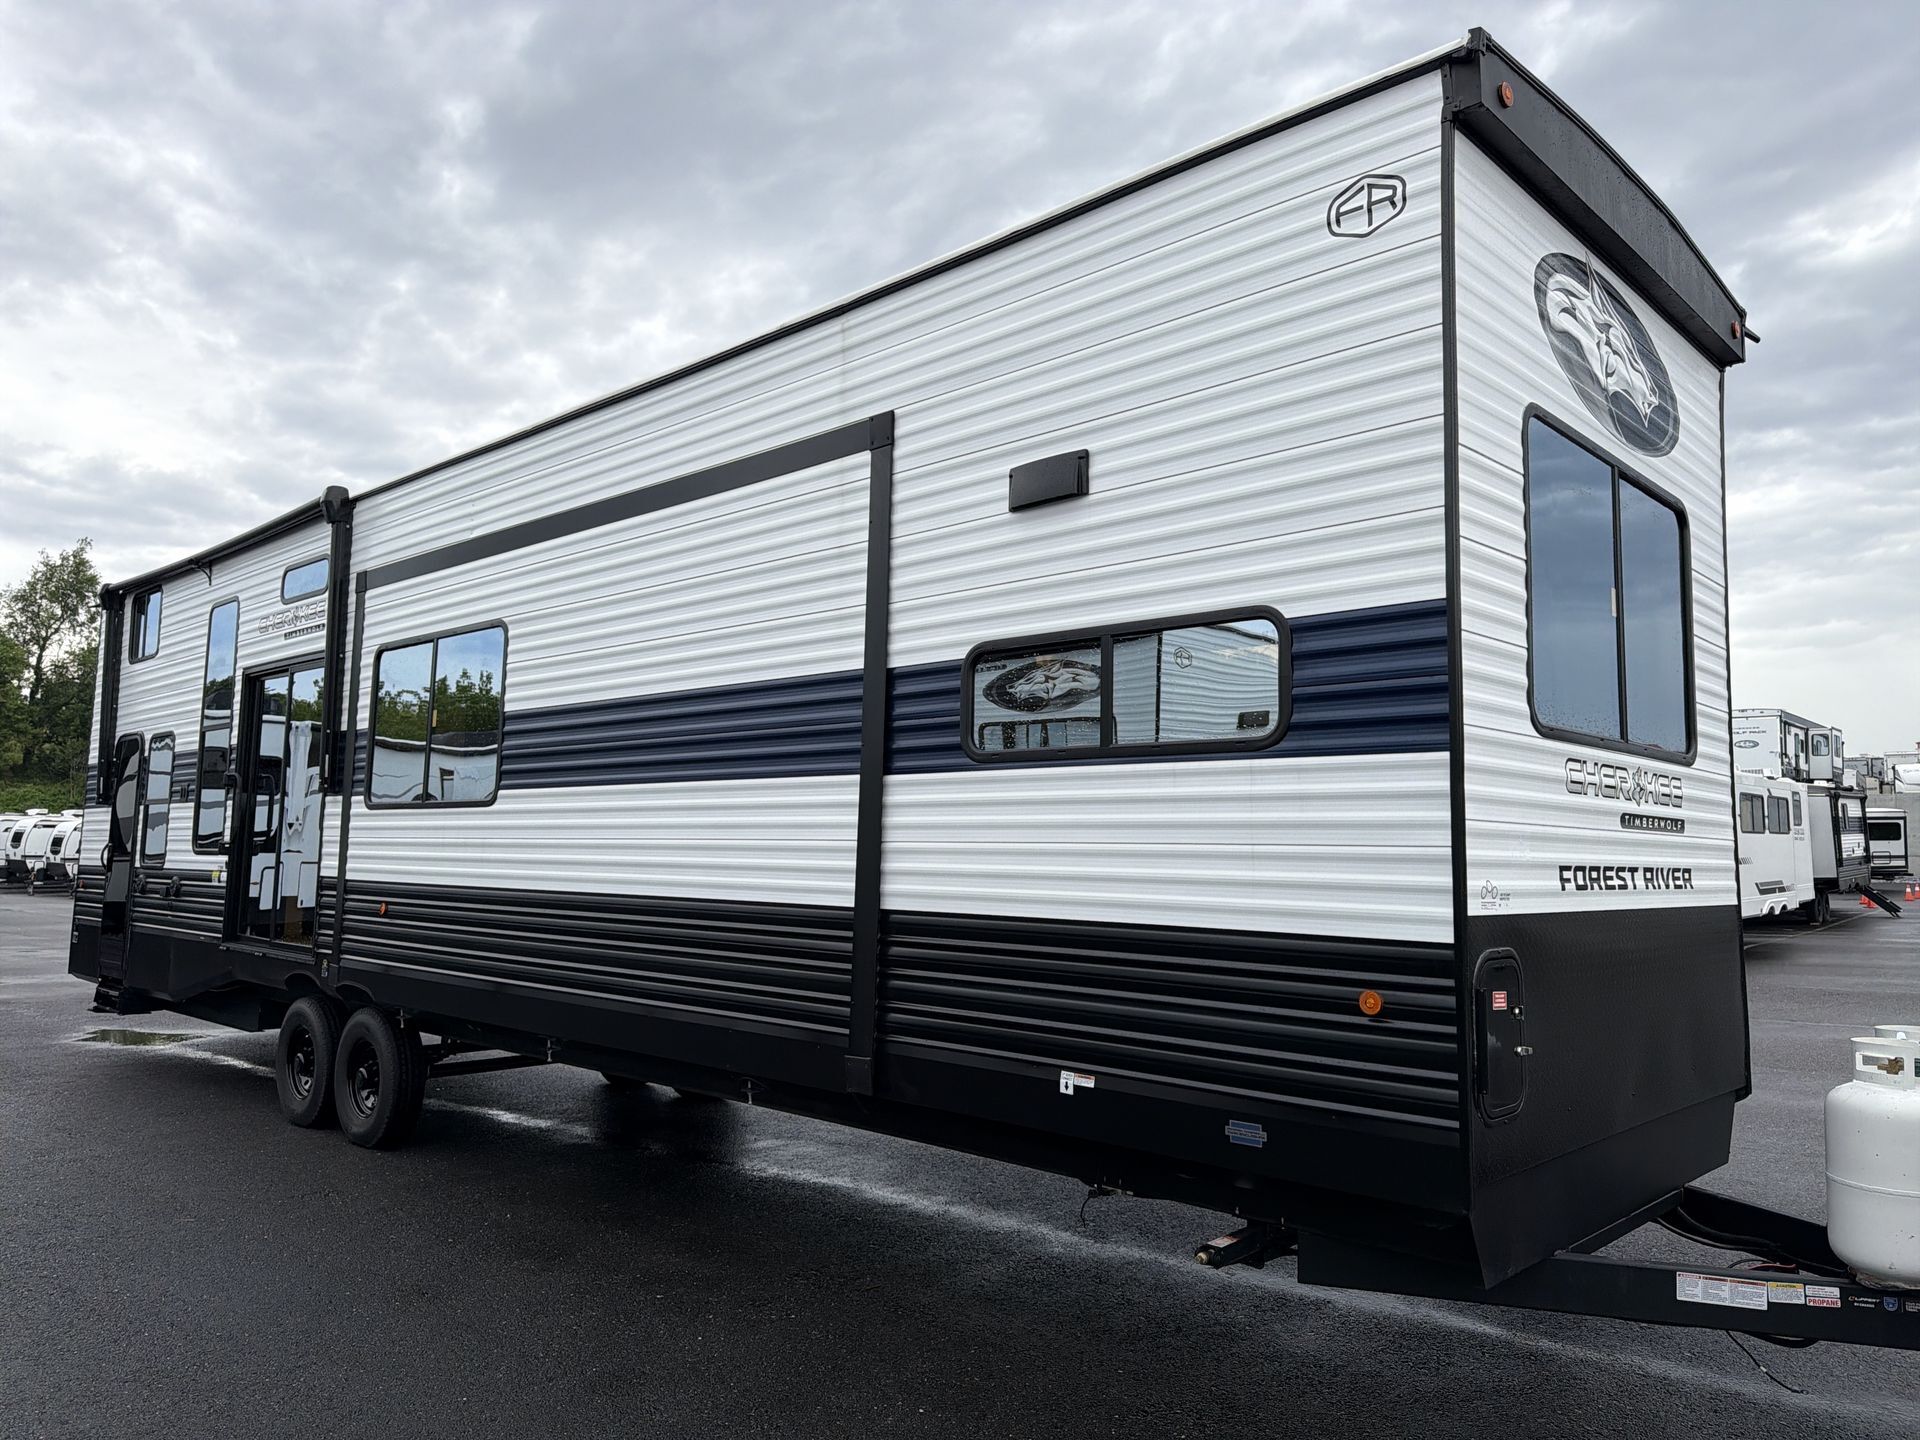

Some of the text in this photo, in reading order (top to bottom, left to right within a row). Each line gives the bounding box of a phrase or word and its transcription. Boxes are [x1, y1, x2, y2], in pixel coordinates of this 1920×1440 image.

[1565, 757, 1683, 808] CHEROKEE
[1624, 815, 1682, 831] TIMBERWOLF
[1558, 865, 1694, 891] FOREST RIVER
[1808, 1298, 1840, 1307] PROPANE
